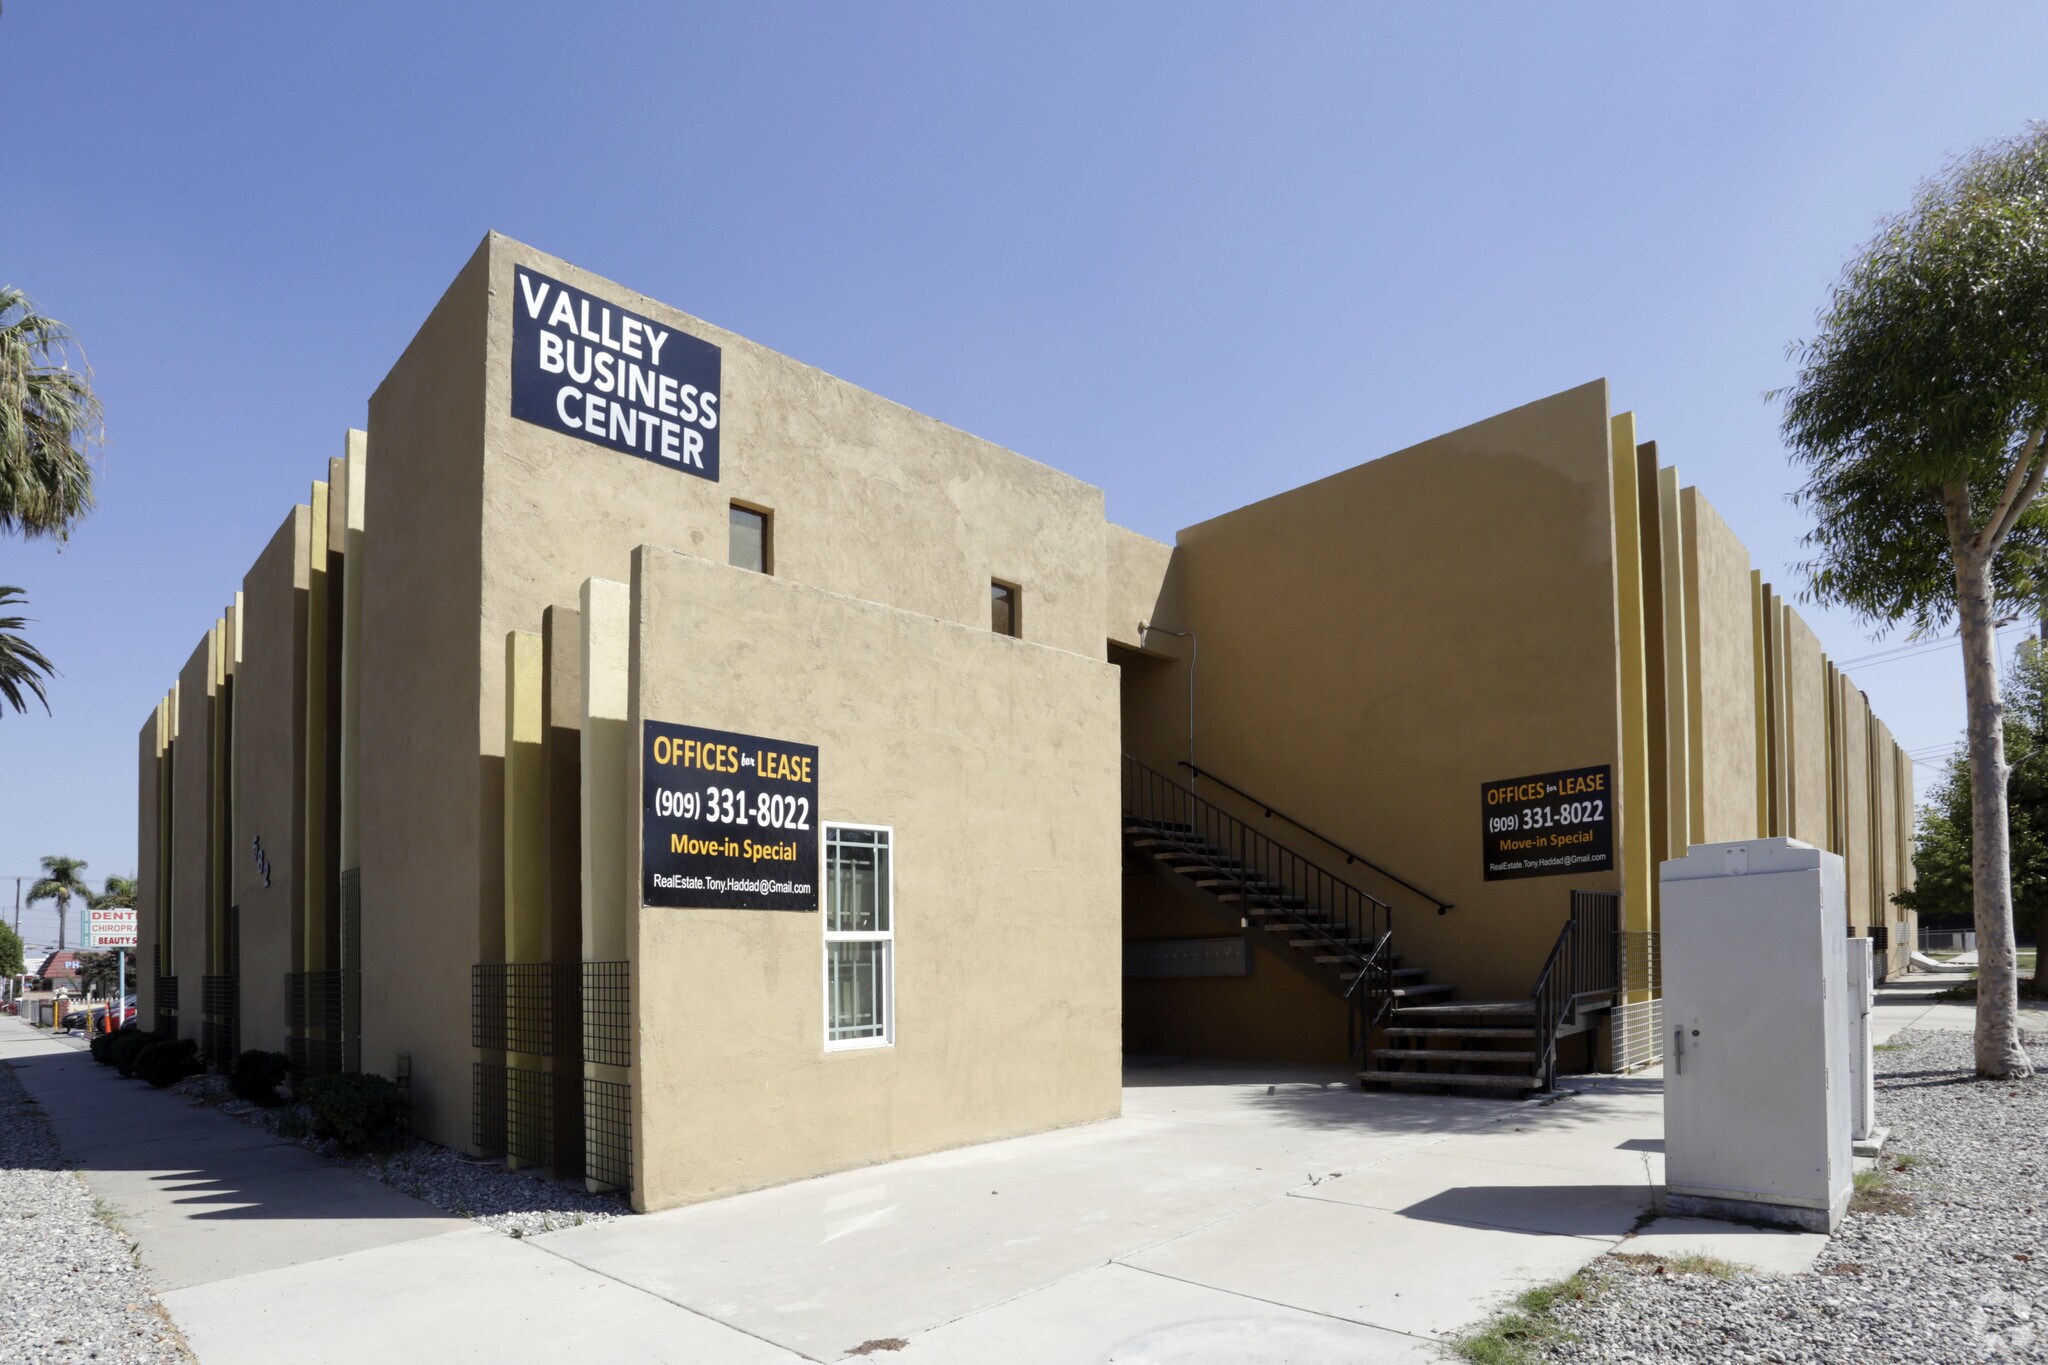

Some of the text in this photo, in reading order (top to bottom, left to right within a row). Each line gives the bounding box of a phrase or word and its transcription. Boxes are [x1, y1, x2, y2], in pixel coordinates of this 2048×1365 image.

[519, 273, 669, 366] VALLEY
[539, 329, 718, 430] BUSINESS
[556, 386, 704, 469] CENTER
[653, 735, 812, 783] OFFICES for LEASE
[1487, 773, 1605, 805] OFFICES for LEASE
[655, 786, 810, 831] (909) 331-8022
[1489, 799, 1604, 833] (909) 331-8022
[670, 833, 797, 863] Move-in Special
[1499, 829, 1593, 851] Move-in Special
[1489, 853, 1606, 871] RealEstate.Tony.Haddad@Gmail.com
[653, 873, 811, 896] RealEstate.Tony.Haddad@Gmail.com
[98, 936, 130, 945] BEAUTY
